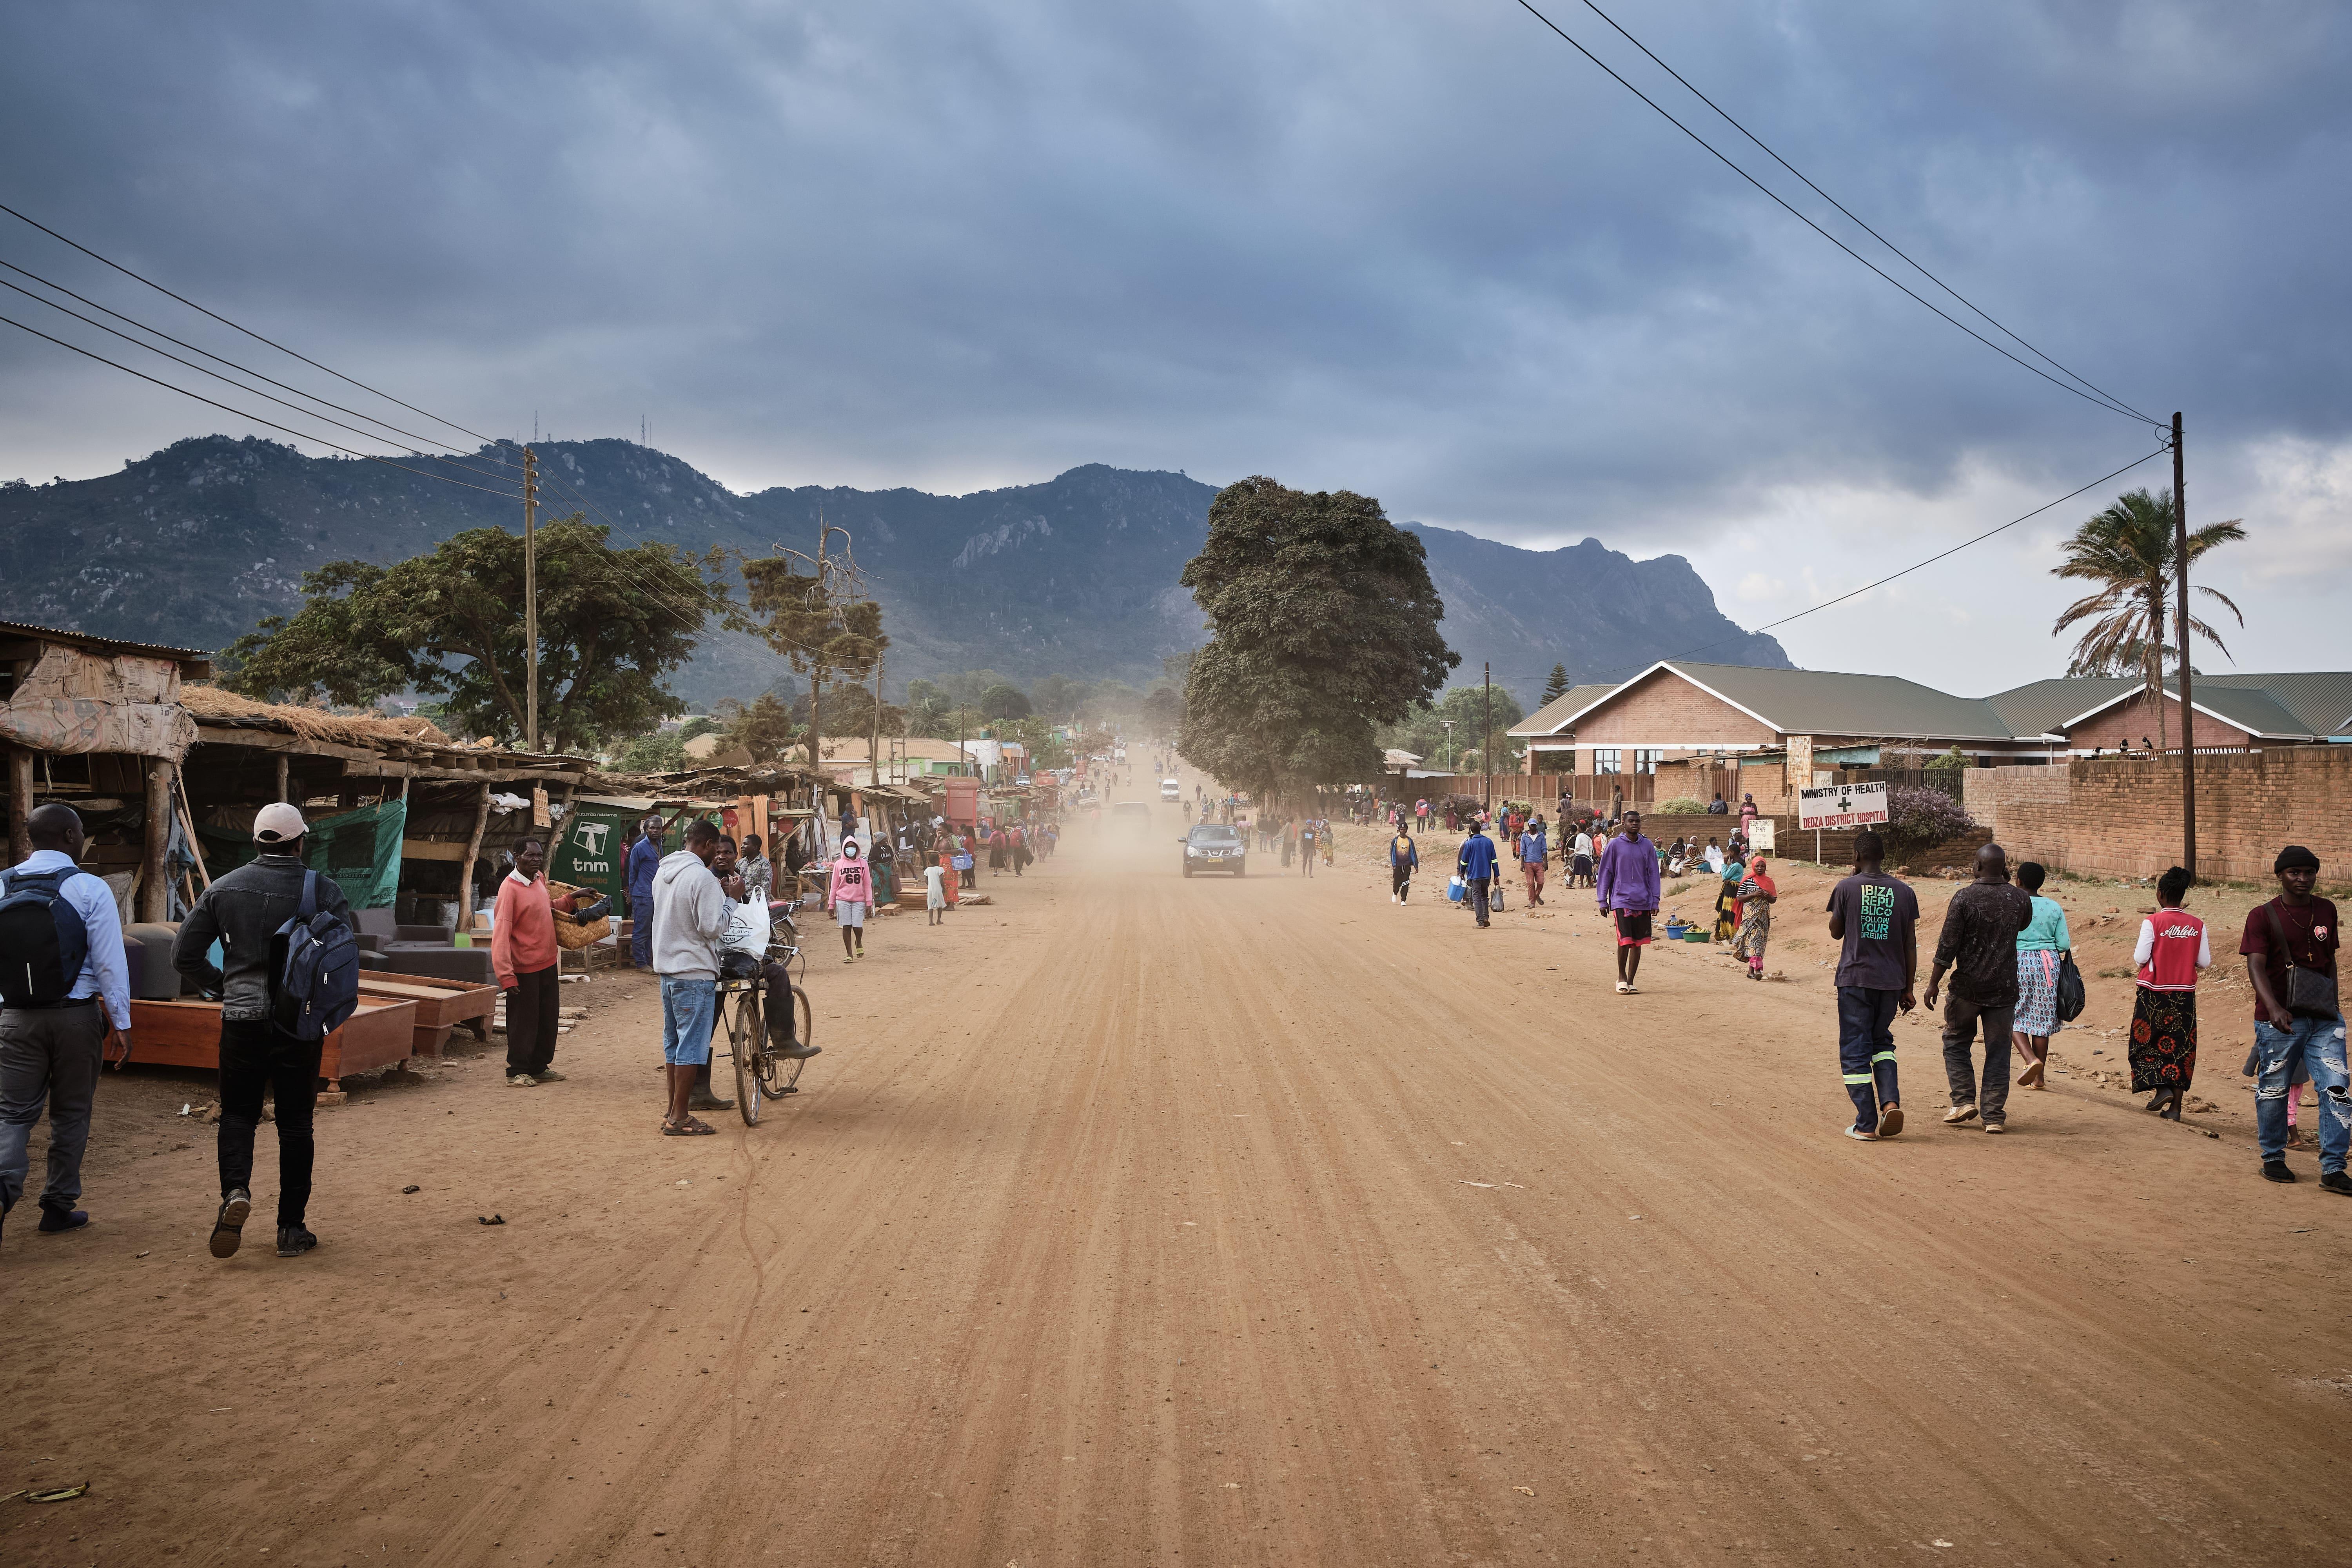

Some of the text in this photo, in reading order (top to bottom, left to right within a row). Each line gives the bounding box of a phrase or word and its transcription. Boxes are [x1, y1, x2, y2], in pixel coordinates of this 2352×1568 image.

[1801, 783, 1885, 799] MINISTRY OF HEALTH
[1803, 810, 1887, 828] DEDZA DISTRICT HOSPITAL
[573, 858, 609, 872] tnm
[576, 875, 608, 885] Mpamba
[846, 874, 861, 884] 68
[1861, 885, 1894, 898] IBIZA
[1861, 895, 1894, 908] REPU
[1861, 916, 1889, 924] FOLLOW
[1861, 922, 1889, 934] YOUR
[2160, 925, 2198, 938] Athletic
